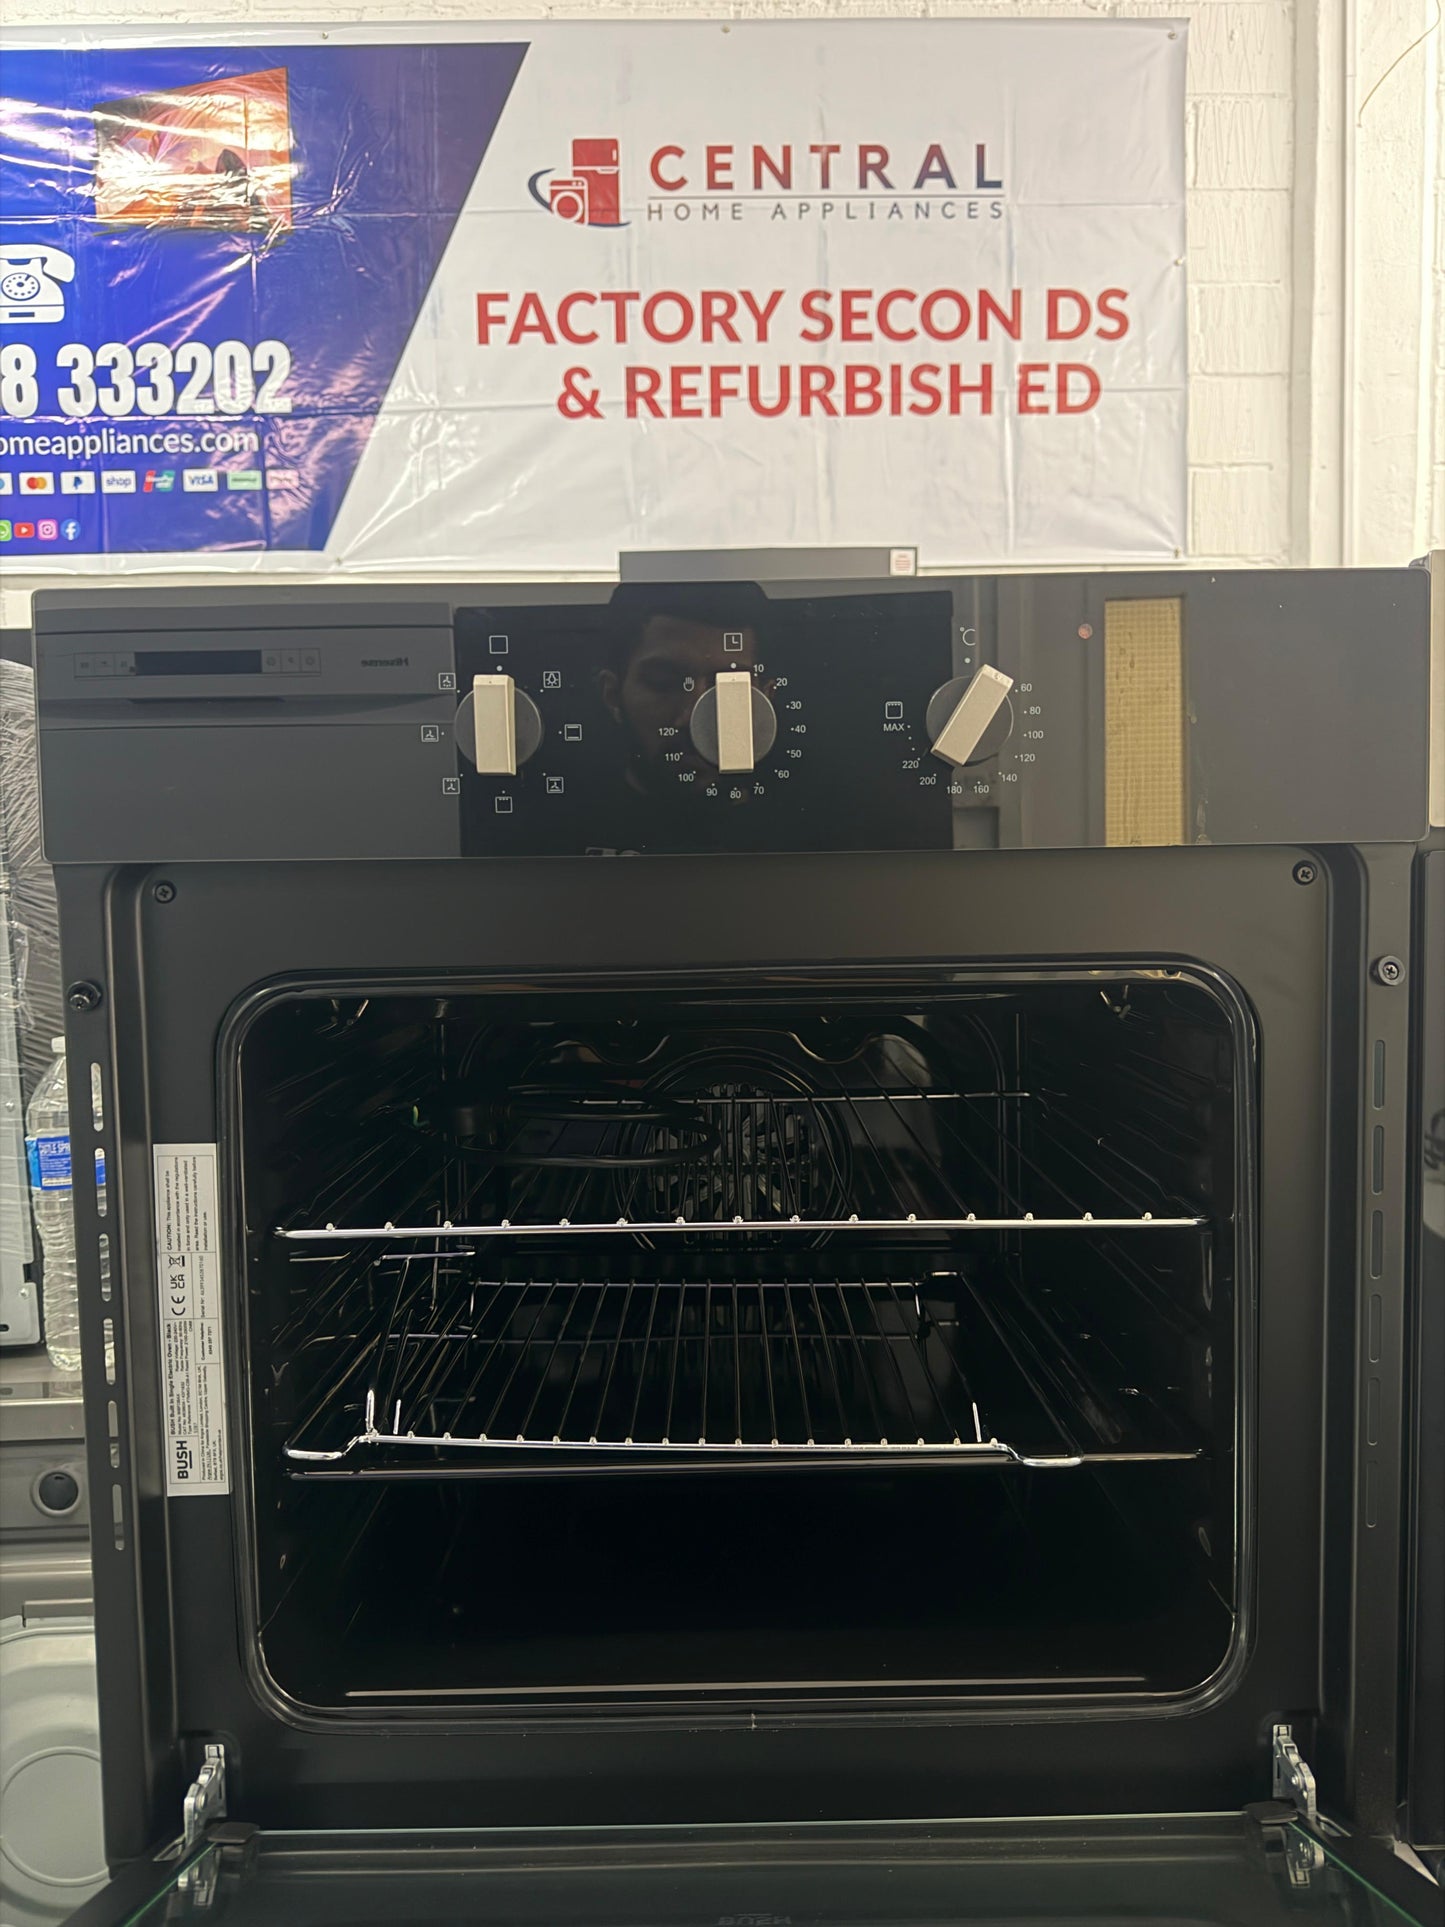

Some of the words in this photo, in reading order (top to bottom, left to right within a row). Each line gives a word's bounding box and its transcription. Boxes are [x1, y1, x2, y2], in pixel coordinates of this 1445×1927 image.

[649, 143, 1004, 191] CENTRAL
[647, 203, 743, 221] HOME
[770, 201, 1004, 221] APPLIANCES
[476, 289, 784, 345] FACTORY
[57, 340, 292, 416] 333202
[557, 366, 603, 420] &
[106, 476, 131, 487] shop
[189, 475, 213, 485] VISA
[753, 664, 764, 673] 10
[776, 677, 788, 687] 20
[1021, 683, 1032, 692] 60
[790, 701, 801, 710] 30
[1029, 706, 1041, 715] 80
[658, 727, 675, 736] 120
[795, 724, 806, 734] 40
[883, 723, 904, 732] MAX
[1027, 730, 1044, 740] 100
[665, 753, 681, 762] 110
[790, 749, 801, 759] 50
[1019, 753, 1035, 763] 120
[902, 760, 919, 769] 220
[678, 773, 694, 782] 100
[778, 770, 789, 779] 60
[1001, 773, 1017, 783] 140
[919, 776, 936, 786] 200
[706, 787, 718, 797] 90
[753, 786, 765, 795] 70
[946, 785, 962, 795] 180
[973, 784, 989, 794] 160
[729, 790, 741, 799] 80
[170, 1274, 178, 1289] UK
[178, 1274, 185, 1289] CA
[176, 1440, 188, 1479] BUSH
